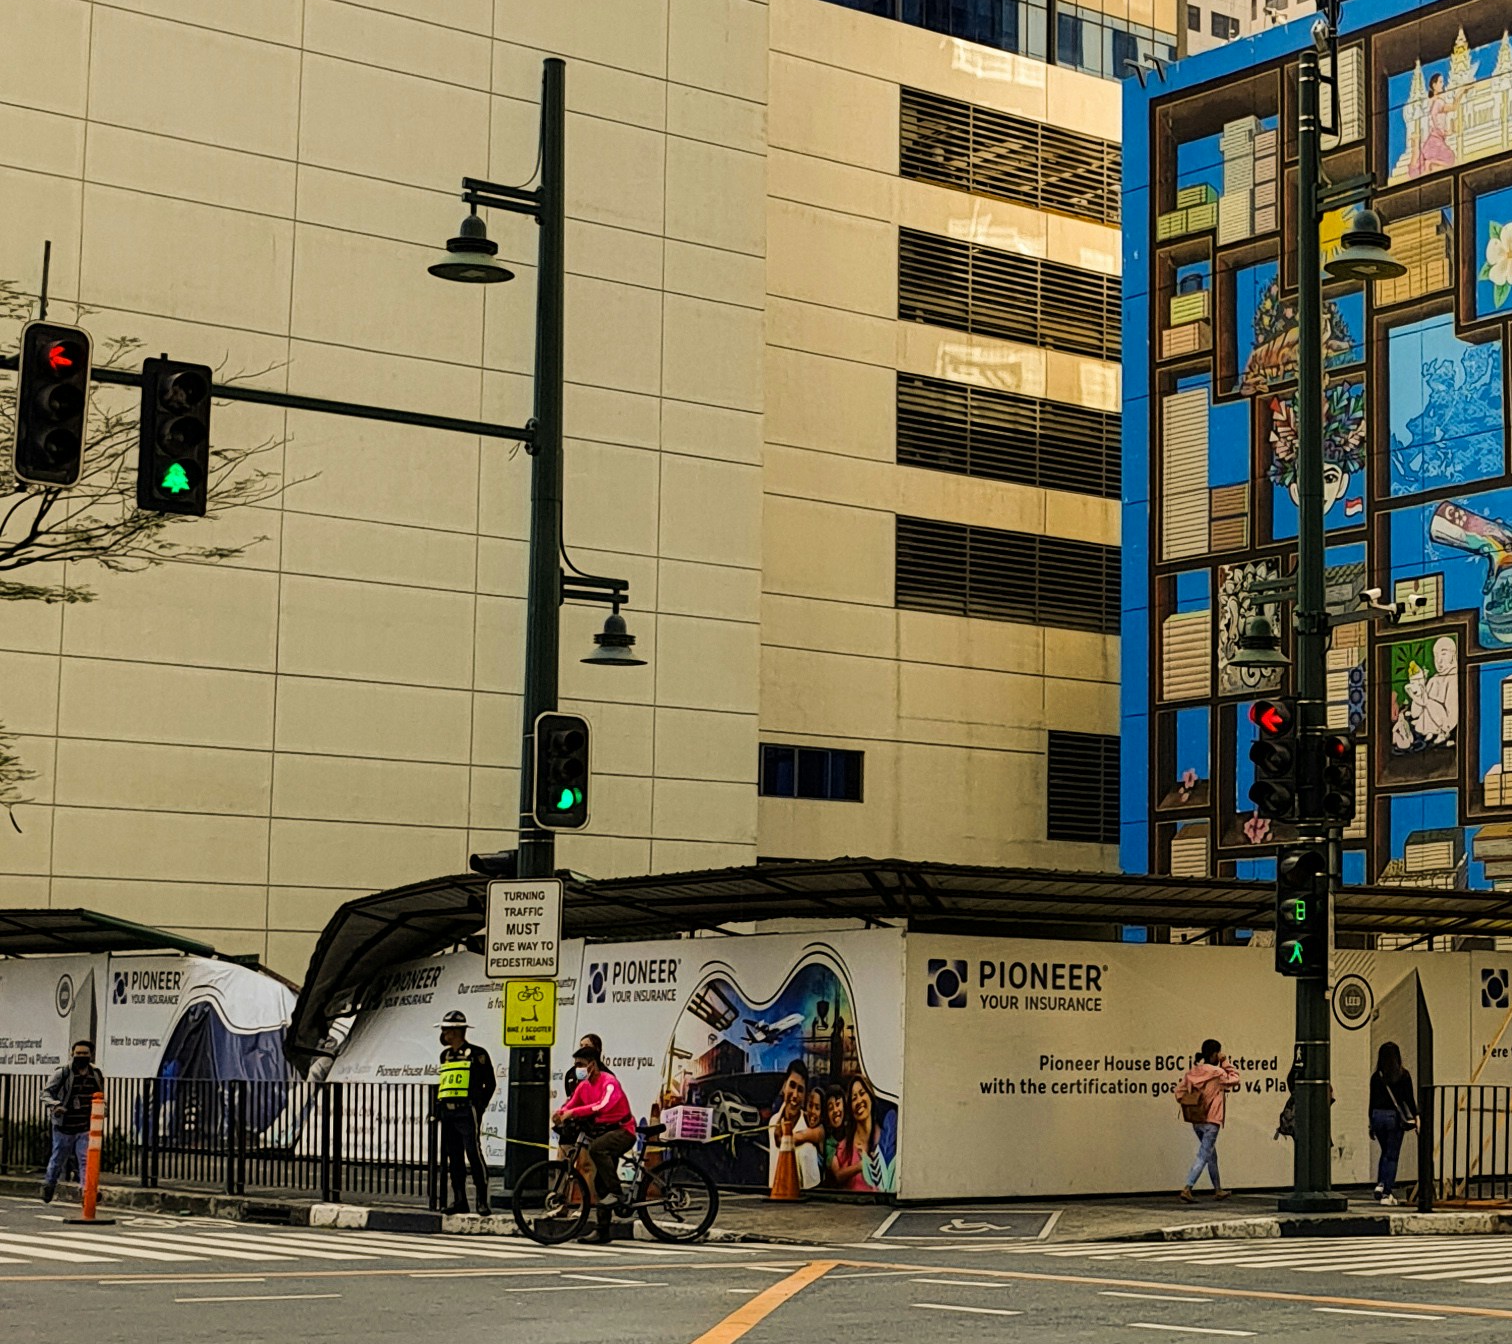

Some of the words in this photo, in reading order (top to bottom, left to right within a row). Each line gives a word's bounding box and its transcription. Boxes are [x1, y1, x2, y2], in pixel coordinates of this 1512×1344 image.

[504, 891, 546, 902] TURNING
[504, 906, 544, 917] TRAFFIC
[506, 922, 541, 935] MUST
[492, 942, 515, 952] GIVE
[517, 941, 539, 952] WAY
[540, 941, 554, 951] TO
[490, 957, 554, 968] PEDESTRIANS
[612, 959, 678, 986] PIONEER
[979, 960, 1102, 992] PIONEER
[131, 970, 182, 990] PIONEER
[131, 994, 146, 1005] YOUR
[147, 994, 180, 1005] INSURANCE
[612, 990, 632, 1004] YOUR
[633, 988, 677, 1003] INSURANCE
[979, 994, 1020, 1010] YOUR
[1024, 996, 1102, 1012] INSURANCE
[124, 1035, 132, 1046] to
[132, 1038, 148, 1047] cover
[612, 1056, 636, 1067] cover
[1039, 1054, 1101, 1071] Pioneer
[1104, 1055, 1151, 1071] House
[1155, 1056, 1185, 1071] BGC
[979, 1077, 1016, 1095] with
[1020, 1077, 1047, 1095] the
[1051, 1077, 1148, 1096] certification
[1245, 1079, 1262, 1094] v4
